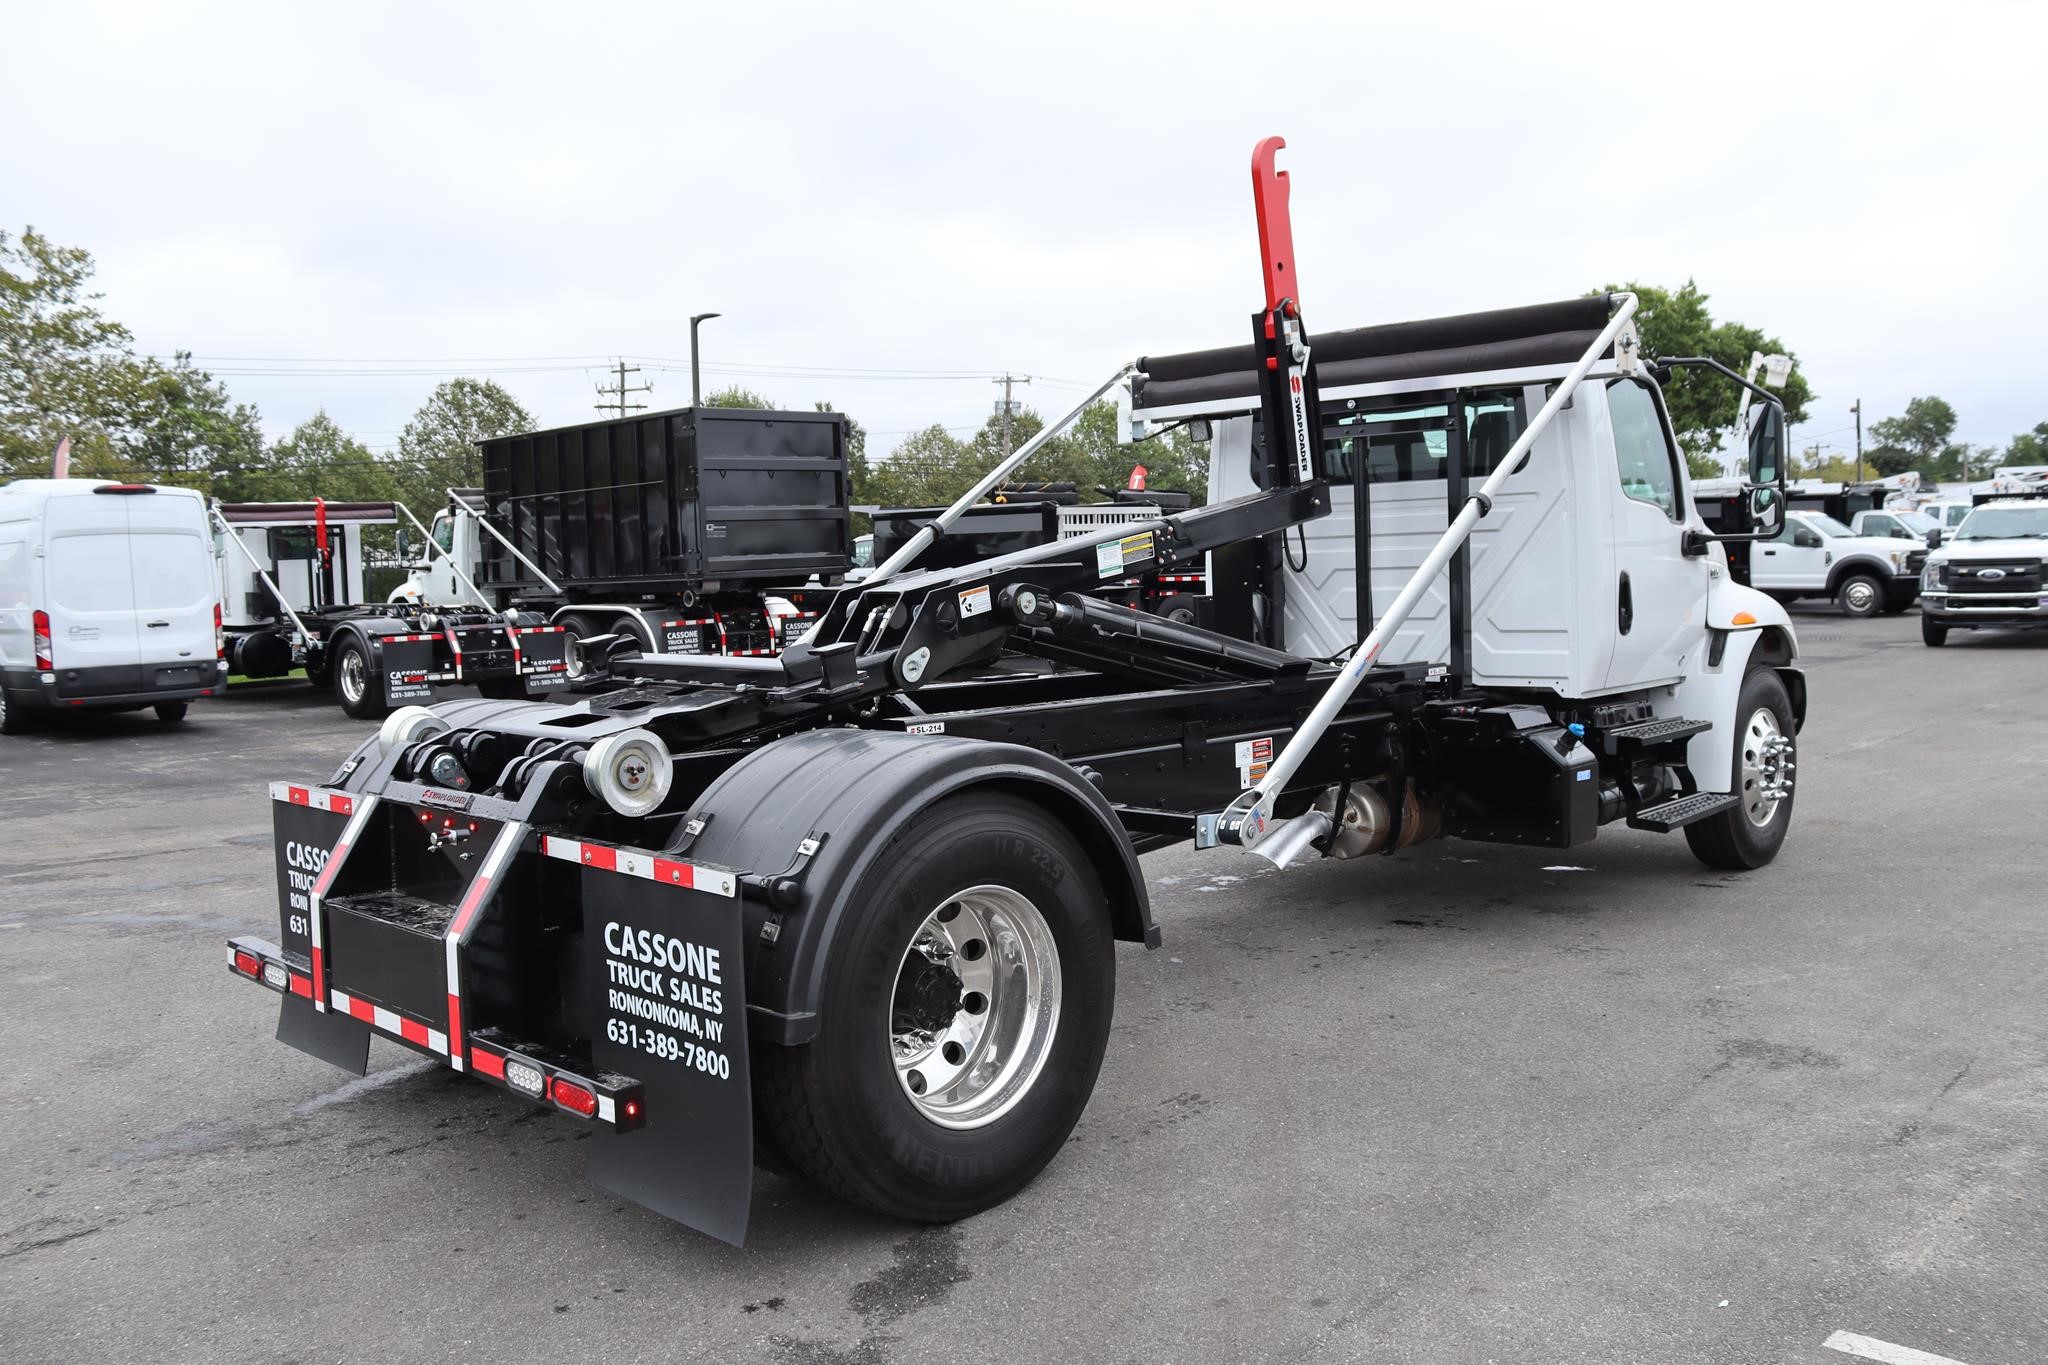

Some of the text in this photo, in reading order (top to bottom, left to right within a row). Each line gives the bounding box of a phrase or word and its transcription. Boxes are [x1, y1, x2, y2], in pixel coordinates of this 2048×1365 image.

[1294, 396, 1308, 472] SWAPLOADER
[667, 630, 698, 639] CASSONE
[916, 725, 941, 734] SL-214
[286, 841, 330, 873] CASSO
[288, 870, 316, 892] TRUC
[604, 921, 722, 985] CASSONE
[606, 959, 723, 1015] TRUCK SALES
[609, 988, 723, 1043] RONKONKOMA, NY
[607, 1018, 730, 1080] 631-389-7800
